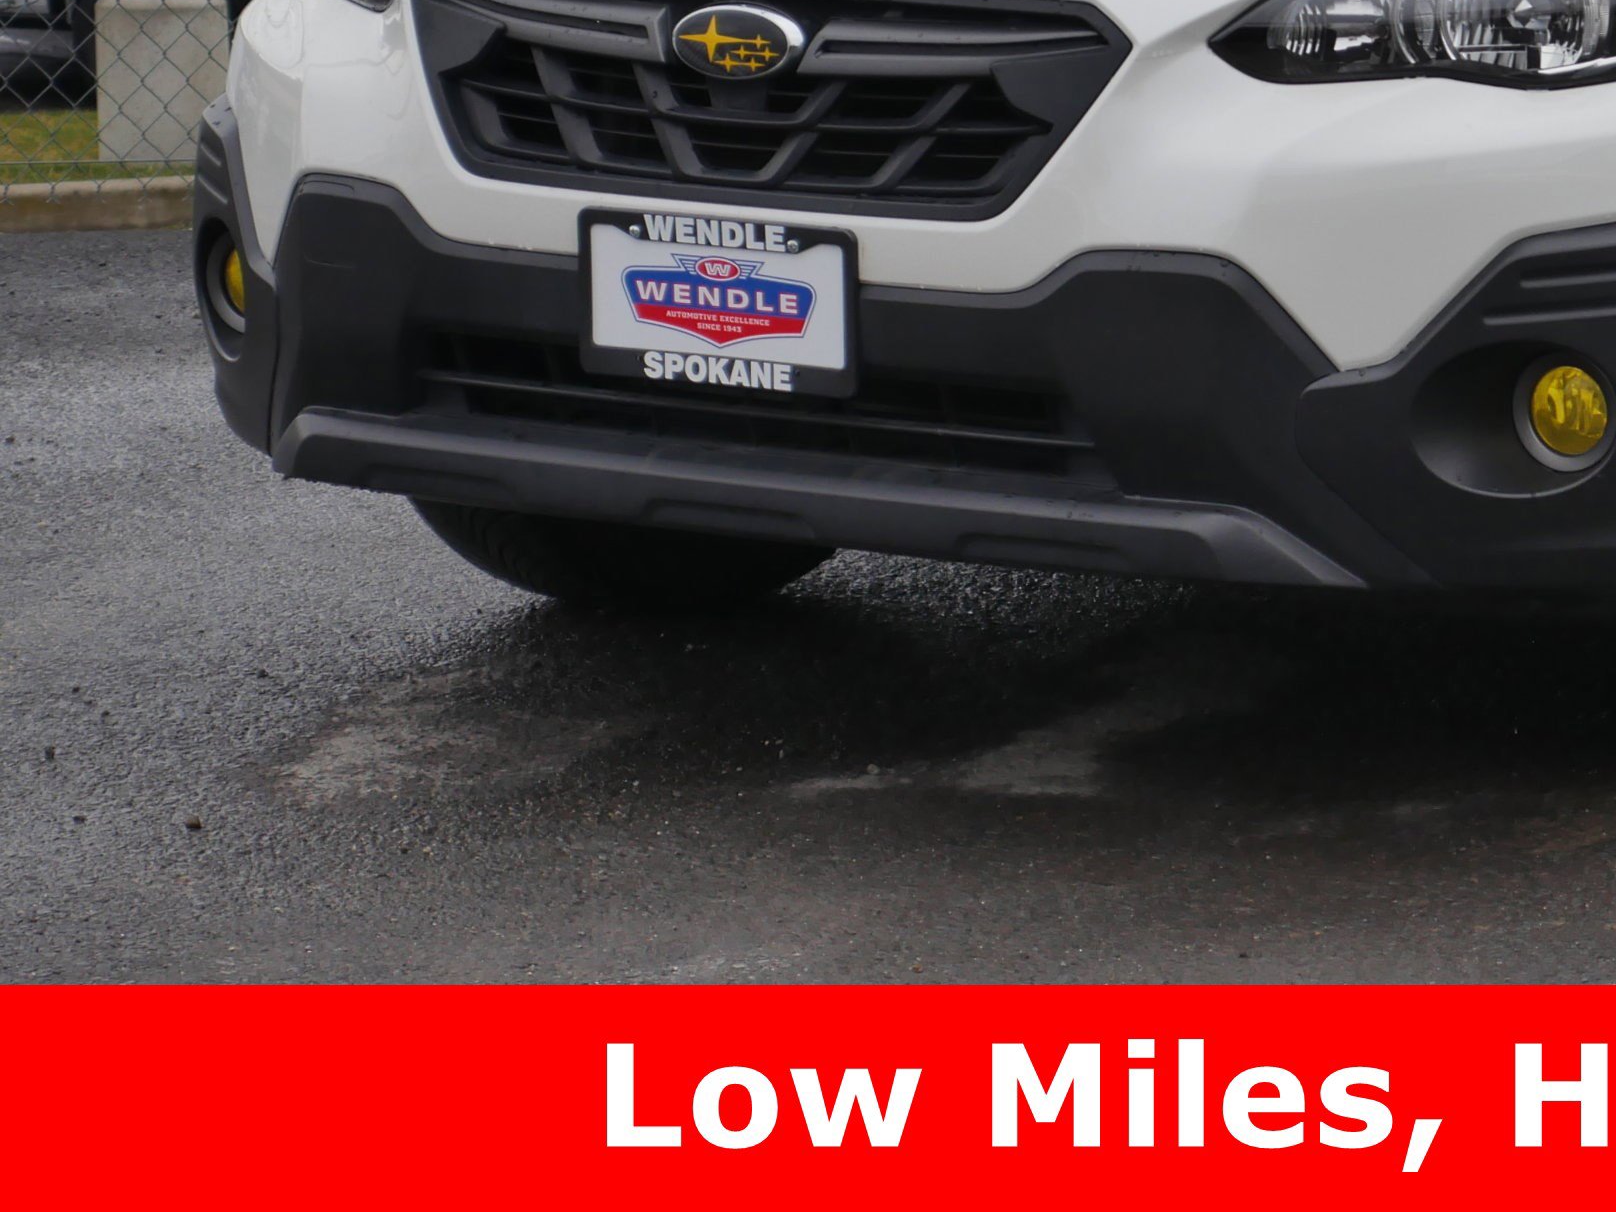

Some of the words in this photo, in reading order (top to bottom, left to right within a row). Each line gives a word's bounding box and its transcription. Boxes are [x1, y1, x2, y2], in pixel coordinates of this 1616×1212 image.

[643, 213, 787, 253] WENDLE
[635, 279, 798, 315] WENDLE
[665, 309, 718, 322] AUTOMOTIVE
[719, 314, 770, 327] EXCELLENCE
[696, 322, 721, 332] SINCE
[722, 324, 742, 334] 1943
[643, 351, 793, 392] SPOKANE
